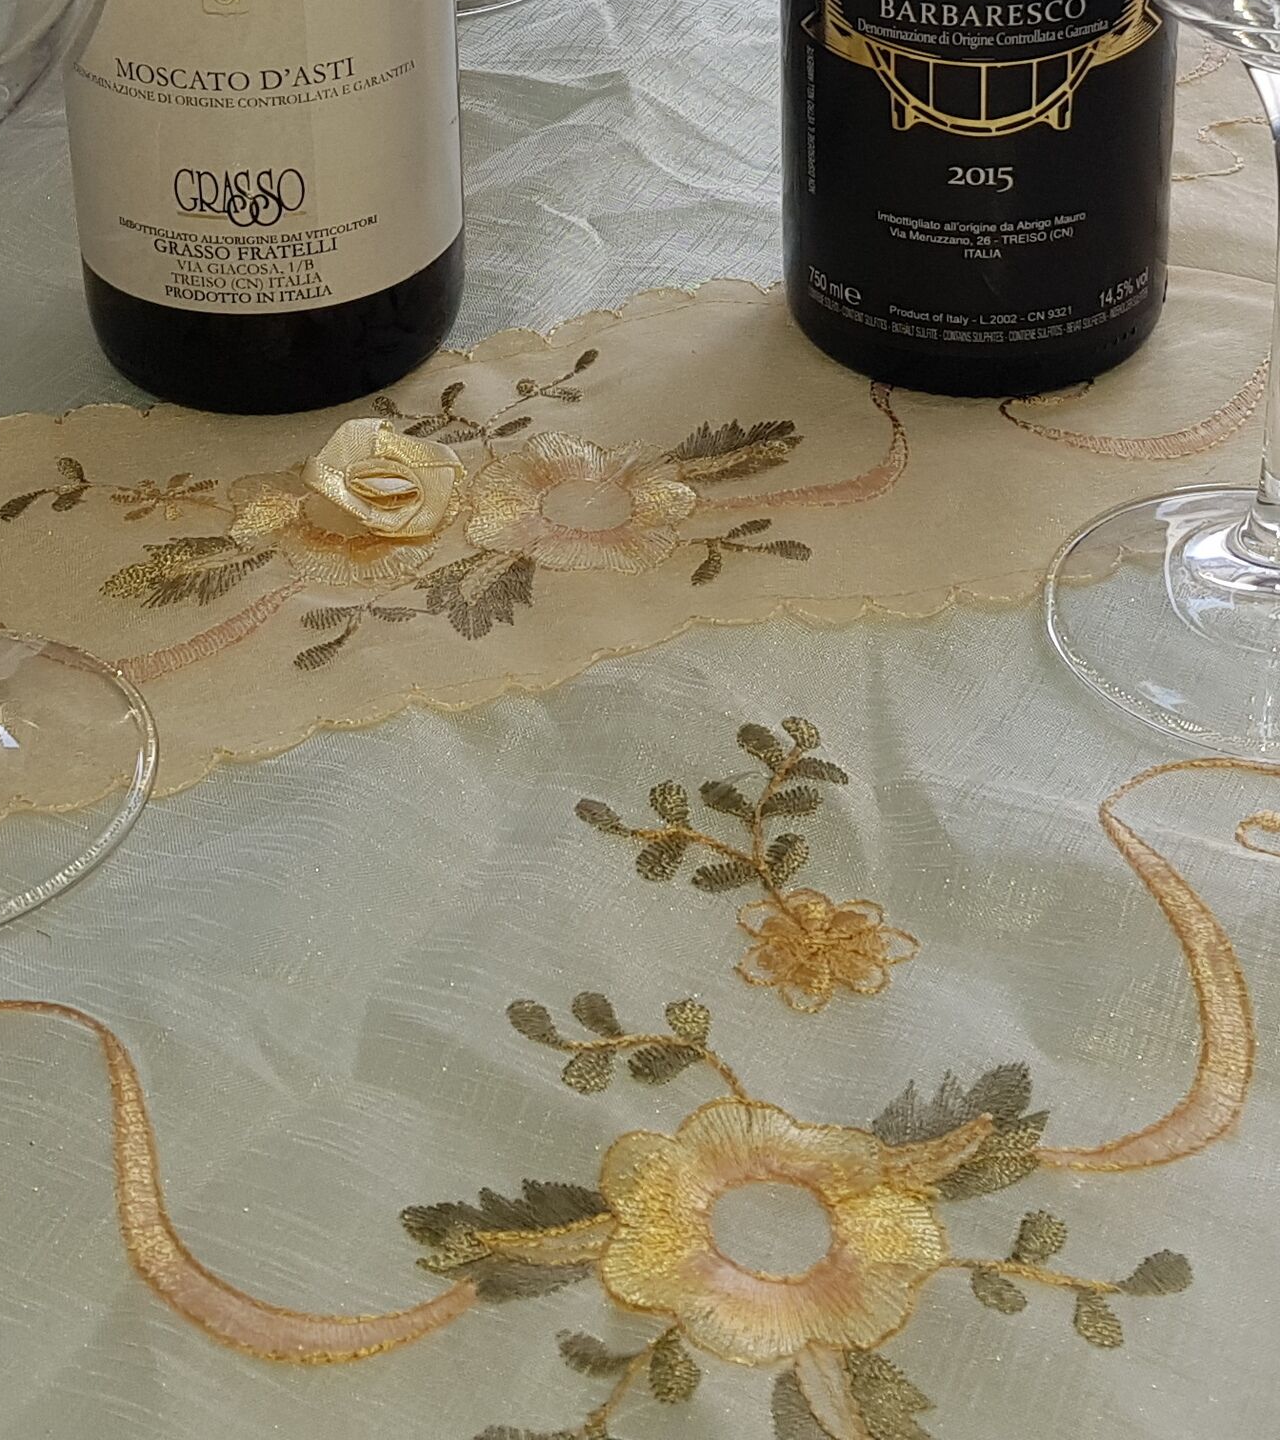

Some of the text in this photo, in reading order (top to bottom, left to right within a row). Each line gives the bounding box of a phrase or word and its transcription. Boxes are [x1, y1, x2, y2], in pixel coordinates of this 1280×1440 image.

[857, 17, 937, 44] Denominazione
[938, 30, 950, 45] di
[952, 31, 994, 50] Origine
[996, 29, 1056, 46] Controllata
[1057, 31, 1064, 40] e
[73, 59, 416, 109] DENOMINAZIONE DI ORIGINE CONTROLLATA E GARANTITA
[114, 56, 355, 92] MOSCATO D'ASTI
[947, 165, 1014, 193] 2015
[173, 168, 305, 227] GRASSO
[118, 214, 378, 246] IMBOTTIGLIATO ALL'ORIGINE DAI VITICOLTORI
[877, 210, 1087, 234] Imbottigliato all'origine da Abrigo Mauro
[153, 236, 338, 262] GRASSO FRATELLI
[889, 226, 907, 239] Via
[976, 235, 992, 246] 26
[1001, 231, 1047, 245] TREISO
[1049, 226, 1074, 242] (CN)
[176, 259, 203, 273] VIA
[288, 258, 315, 273] 1/B
[964, 248, 1002, 259] ITALIA
[171, 271, 322, 292] TREISO (CN) ITALIA
[807, 265, 827, 292] 750
[1099, 277, 1134, 308] 14,5%
[1135, 266, 1149, 289] vol
[165, 284, 333, 304] PRODOTTO IN ITALIA
[889, 305, 930, 321] Product
[932, 312, 944, 323] of
[946, 313, 969, 327] Italy
[1027, 311, 1045, 323] CN
[1047, 305, 1072, 320] 9321
